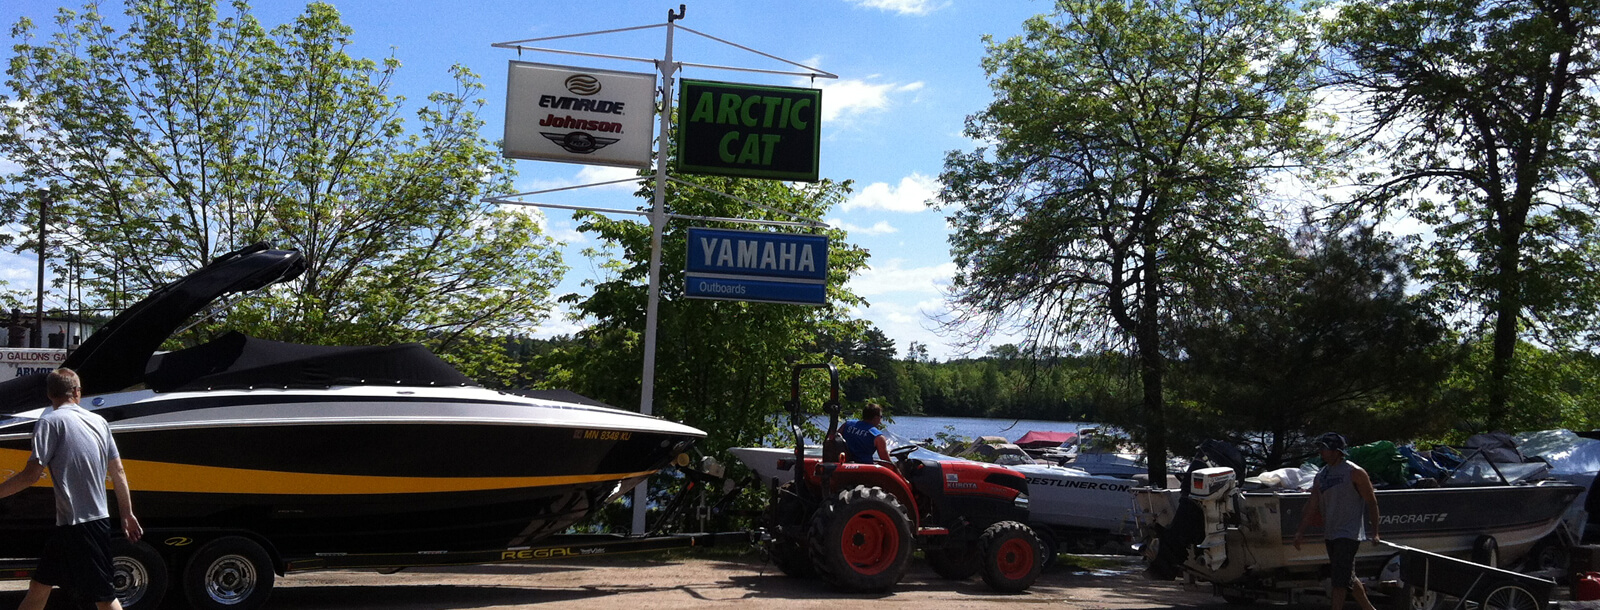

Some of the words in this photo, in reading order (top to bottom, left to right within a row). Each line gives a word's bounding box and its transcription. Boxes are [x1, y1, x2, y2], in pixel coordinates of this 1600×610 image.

[539, 95, 624, 115] EVINRUDE
[690, 92, 811, 130] ARCTIC
[539, 114, 623, 133] Johnson
[718, 131, 781, 166] CAT
[701, 237, 815, 272] YAMAHA
[700, 281, 746, 294] Outboards
[7, 352, 50, 361] GALLONS
[53, 353, 67, 361] GA
[584, 430, 599, 440] MN
[846, 426, 870, 437] STAFF
[1026, 477, 1098, 490] RESTLINER
[1378, 513, 1438, 525] TARCRAFT
[501, 547, 579, 560] REGAL
